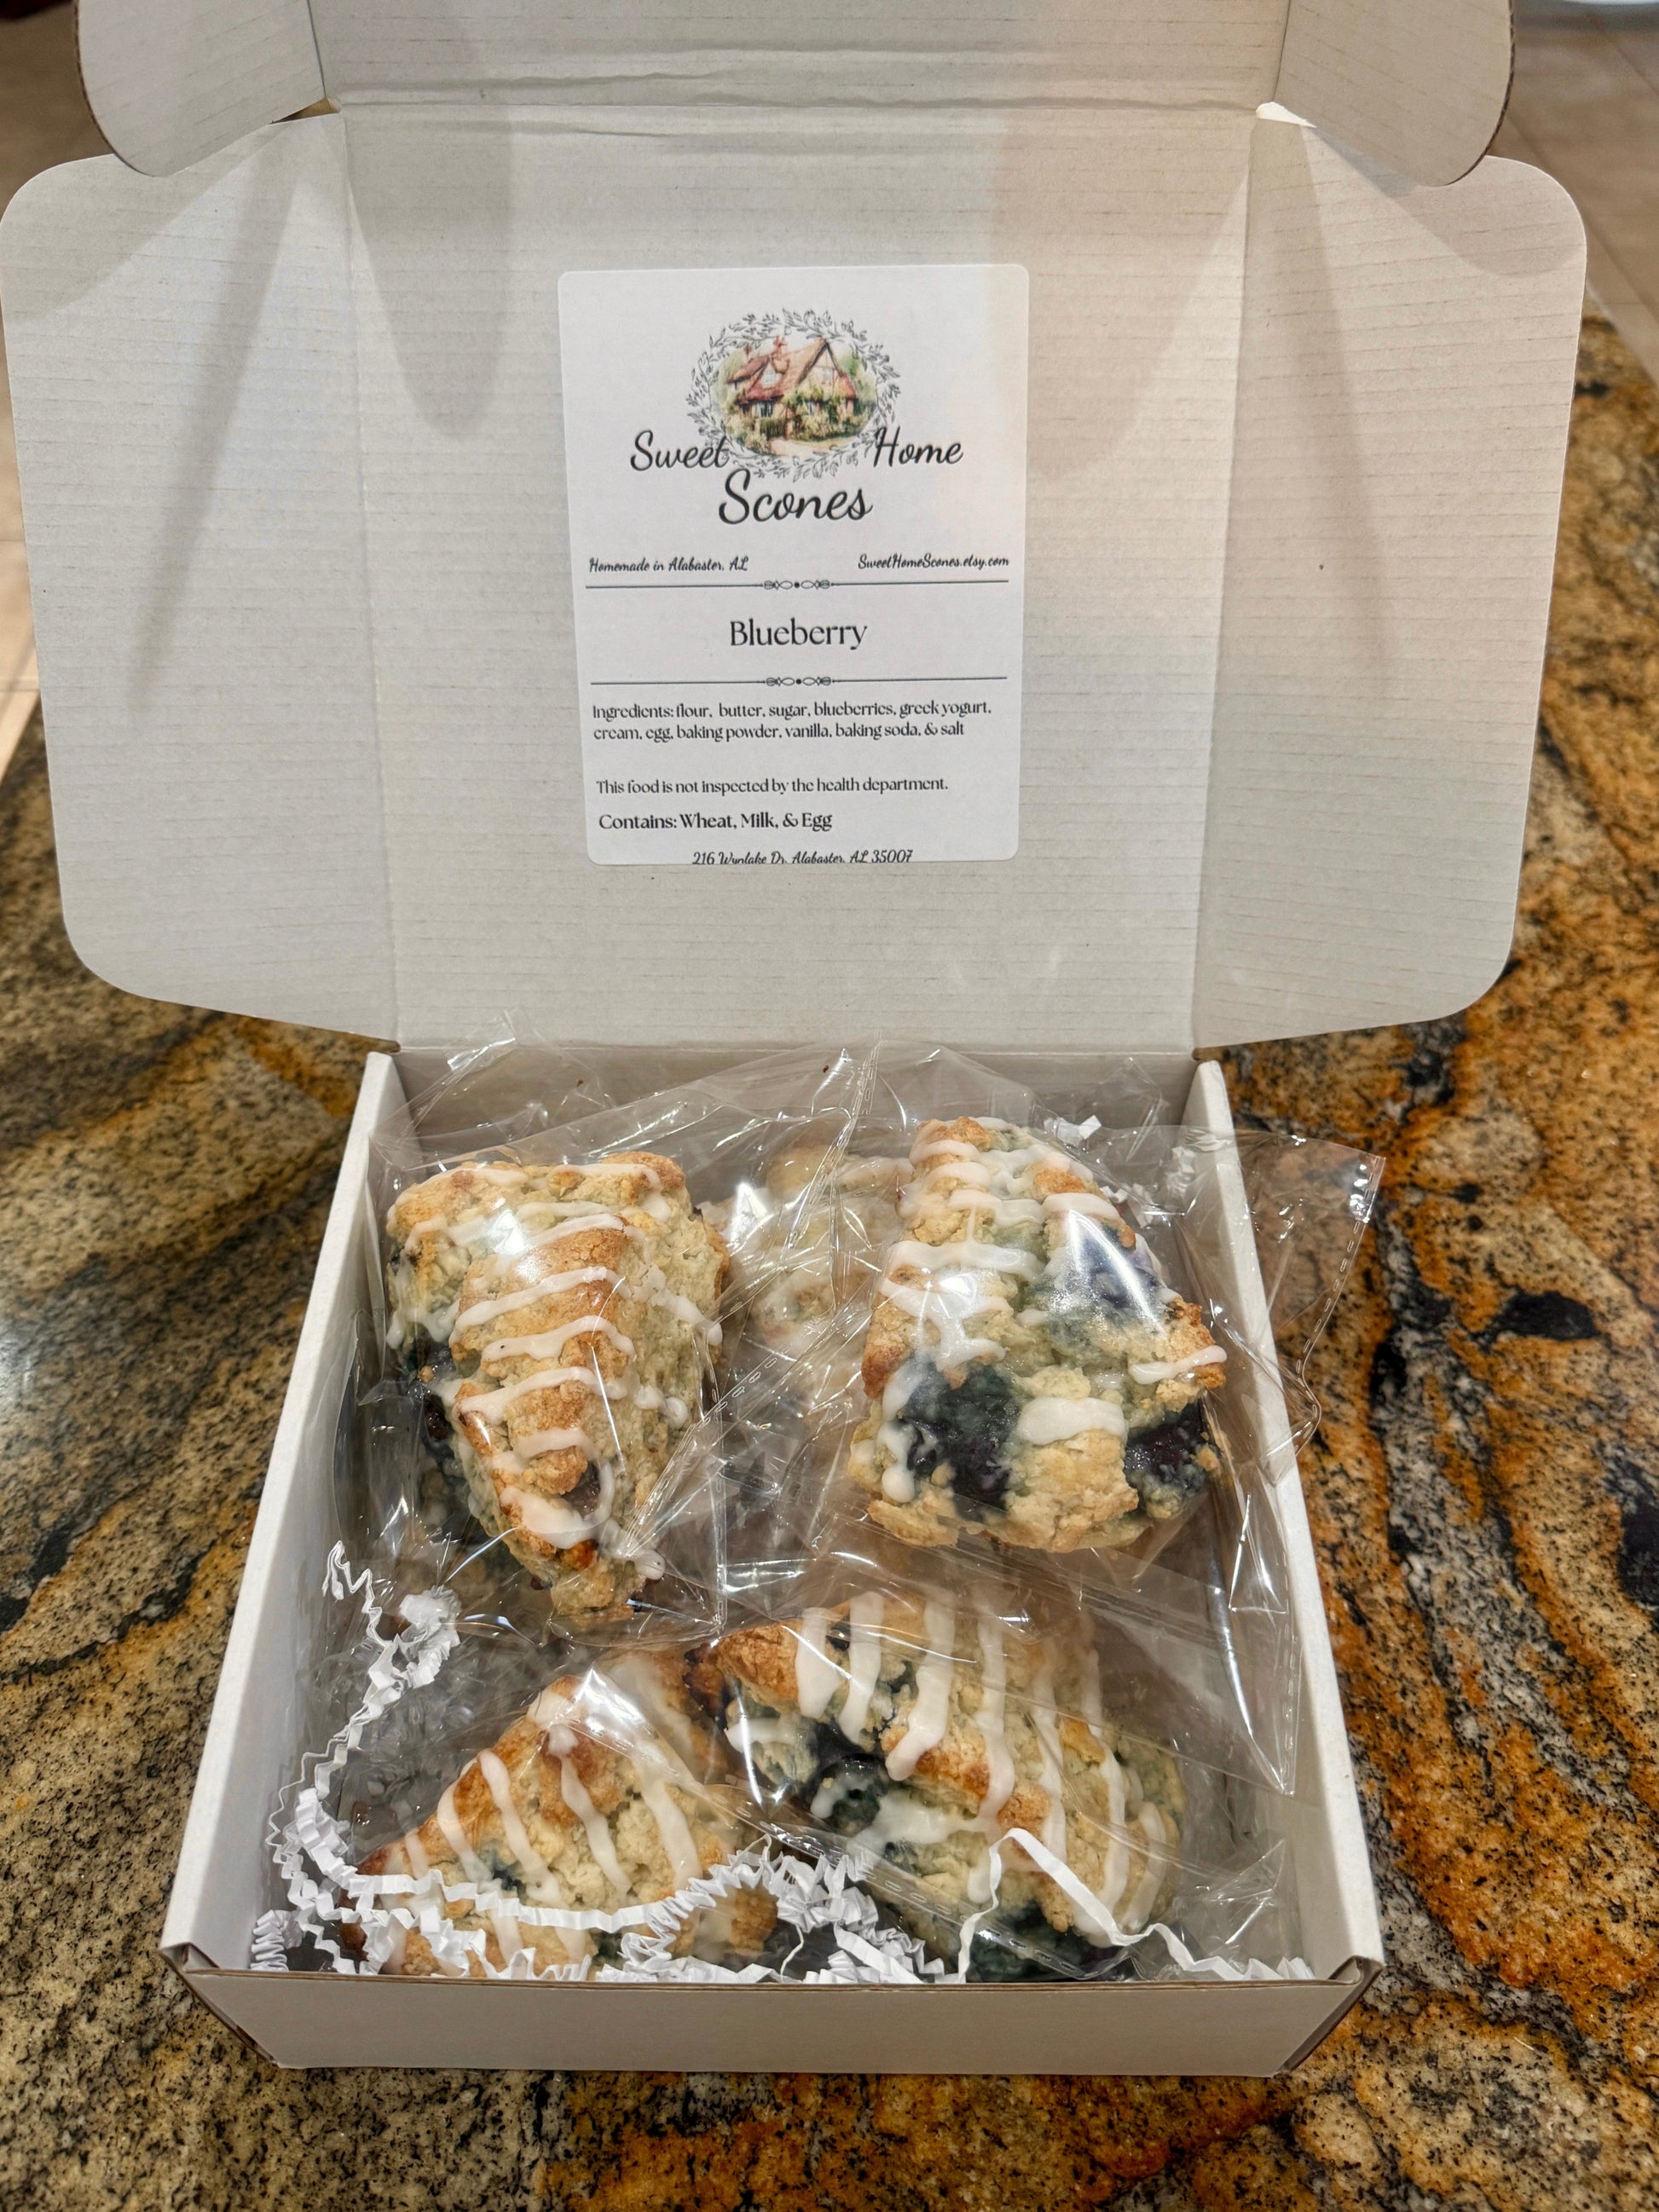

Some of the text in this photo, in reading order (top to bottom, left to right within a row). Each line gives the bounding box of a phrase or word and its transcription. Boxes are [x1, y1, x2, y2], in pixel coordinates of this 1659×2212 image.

[630, 426, 964, 471] Sweet Home
[718, 469, 873, 525] Scones
[589, 557, 650, 573] Homemade
[653, 560, 664, 572] in
[729, 555, 749, 572] AL
[858, 552, 1009, 571] SweetHomeScones.etsy.com
[730, 617, 868, 651] Blueberry
[592, 703, 673, 723] Ingredients:
[899, 699, 939, 719] greek
[677, 725, 723, 743] baking
[835, 722, 882, 741] baking
[924, 722, 939, 736] &
[940, 721, 965, 736] salt
[596, 777, 949, 797] This food is not inspected by the health department.
[598, 811, 833, 832] Contains: Wheat, Milk, & Egg
[691, 851, 716, 865] 216
[849, 848, 868, 863] AL
[870, 848, 914, 863] 35007
